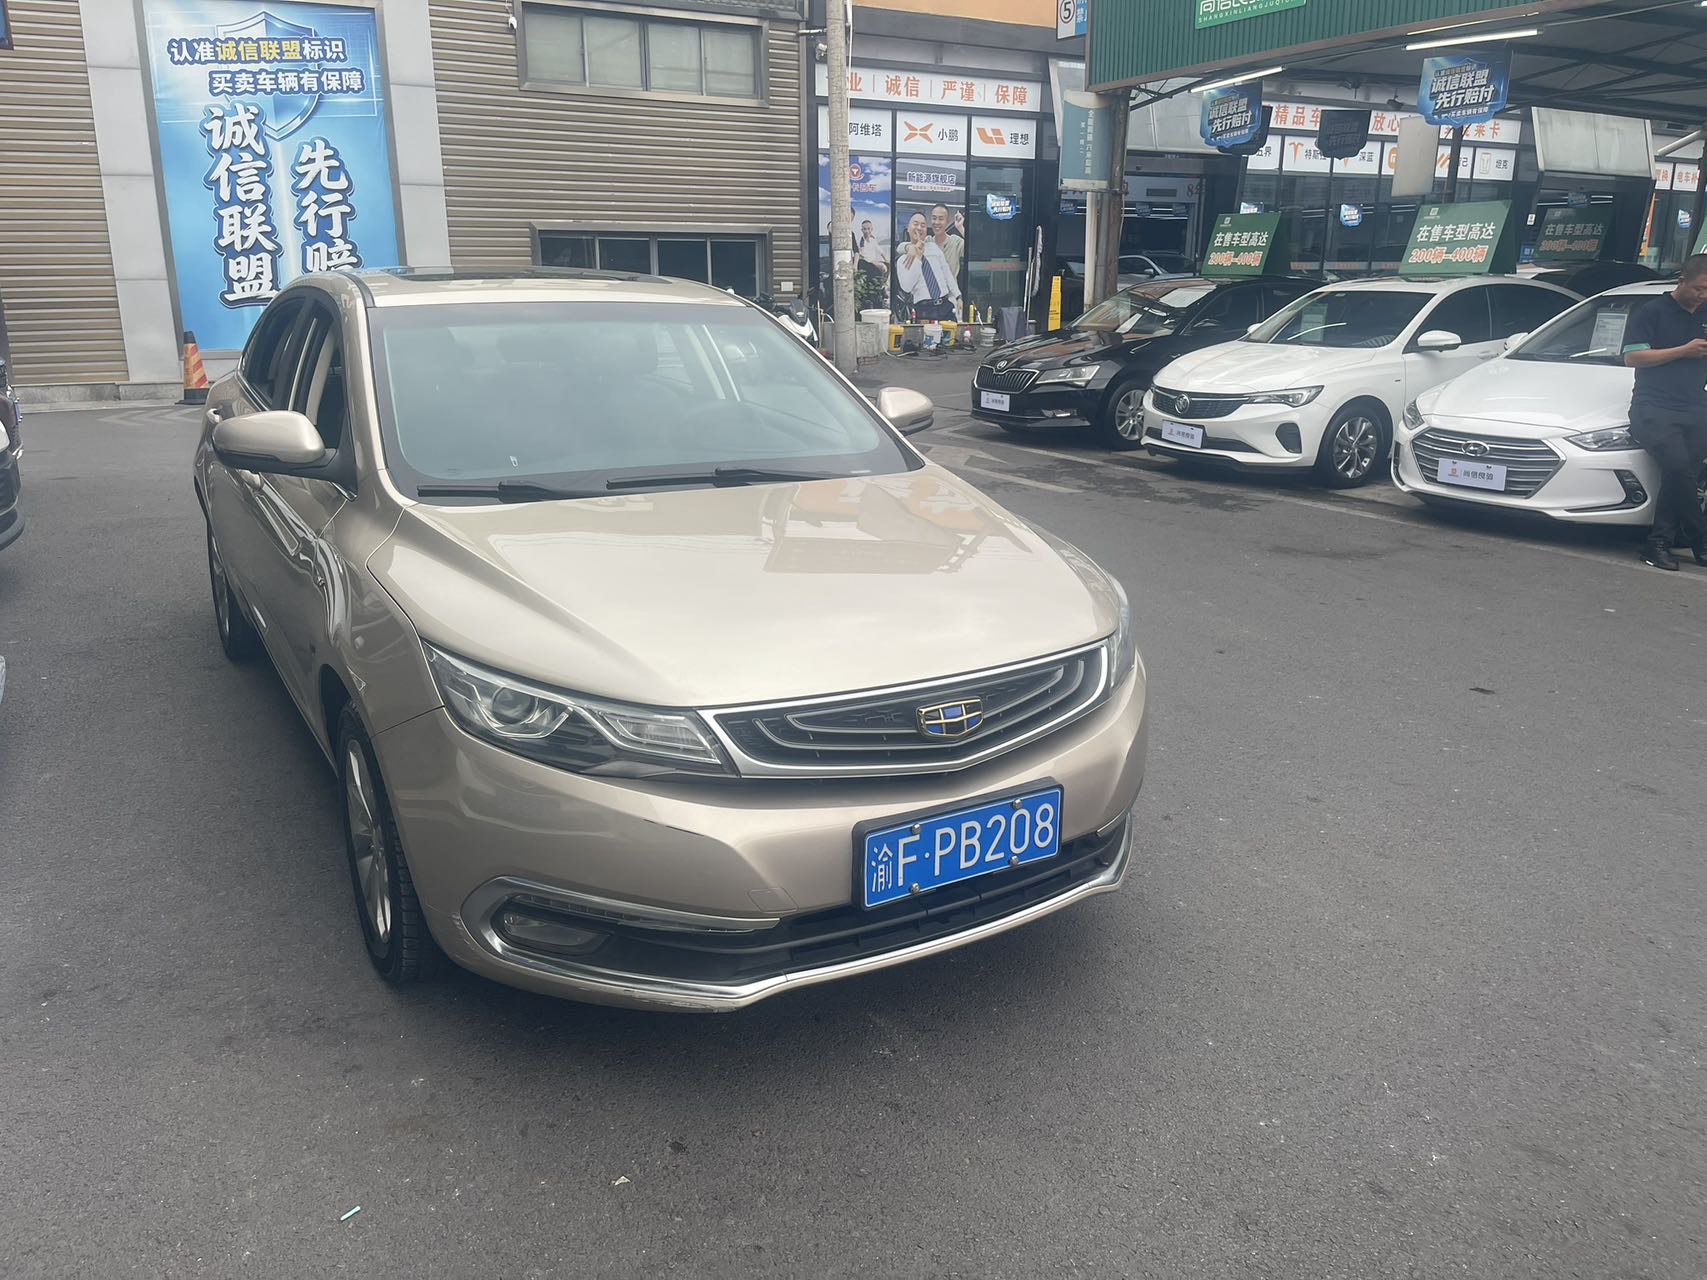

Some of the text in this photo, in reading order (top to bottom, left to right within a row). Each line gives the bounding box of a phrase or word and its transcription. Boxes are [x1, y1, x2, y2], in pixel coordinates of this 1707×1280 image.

[170, 39, 345, 62] 认准诚信联盟标识
[211, 71, 363, 93] 买卖车辆有保障
[885, 75, 921, 97] 诚信
[941, 80, 976, 102] 严谨
[995, 84, 1028, 106] 保障
[1431, 69, 1490, 94] 诚信联盟
[1208, 97, 1248, 120] 诚信联盟
[1435, 84, 1495, 110] 先行赔付
[848, 122, 882, 137] 阿维塔
[1212, 110, 1253, 133] 先行赔付
[1274, 104, 1321, 127] 精品车
[1371, 112, 1400, 132] 放心
[937, 128, 959, 142] 小鹏
[1009, 132, 1030, 146] 理想
[1304, 149, 1326, 161] 特斯
[203, 103, 280, 301] 诚信联盟
[1213, 231, 1269, 247] 在售车型高达
[1416, 221, 1496, 242] 在售车型高达
